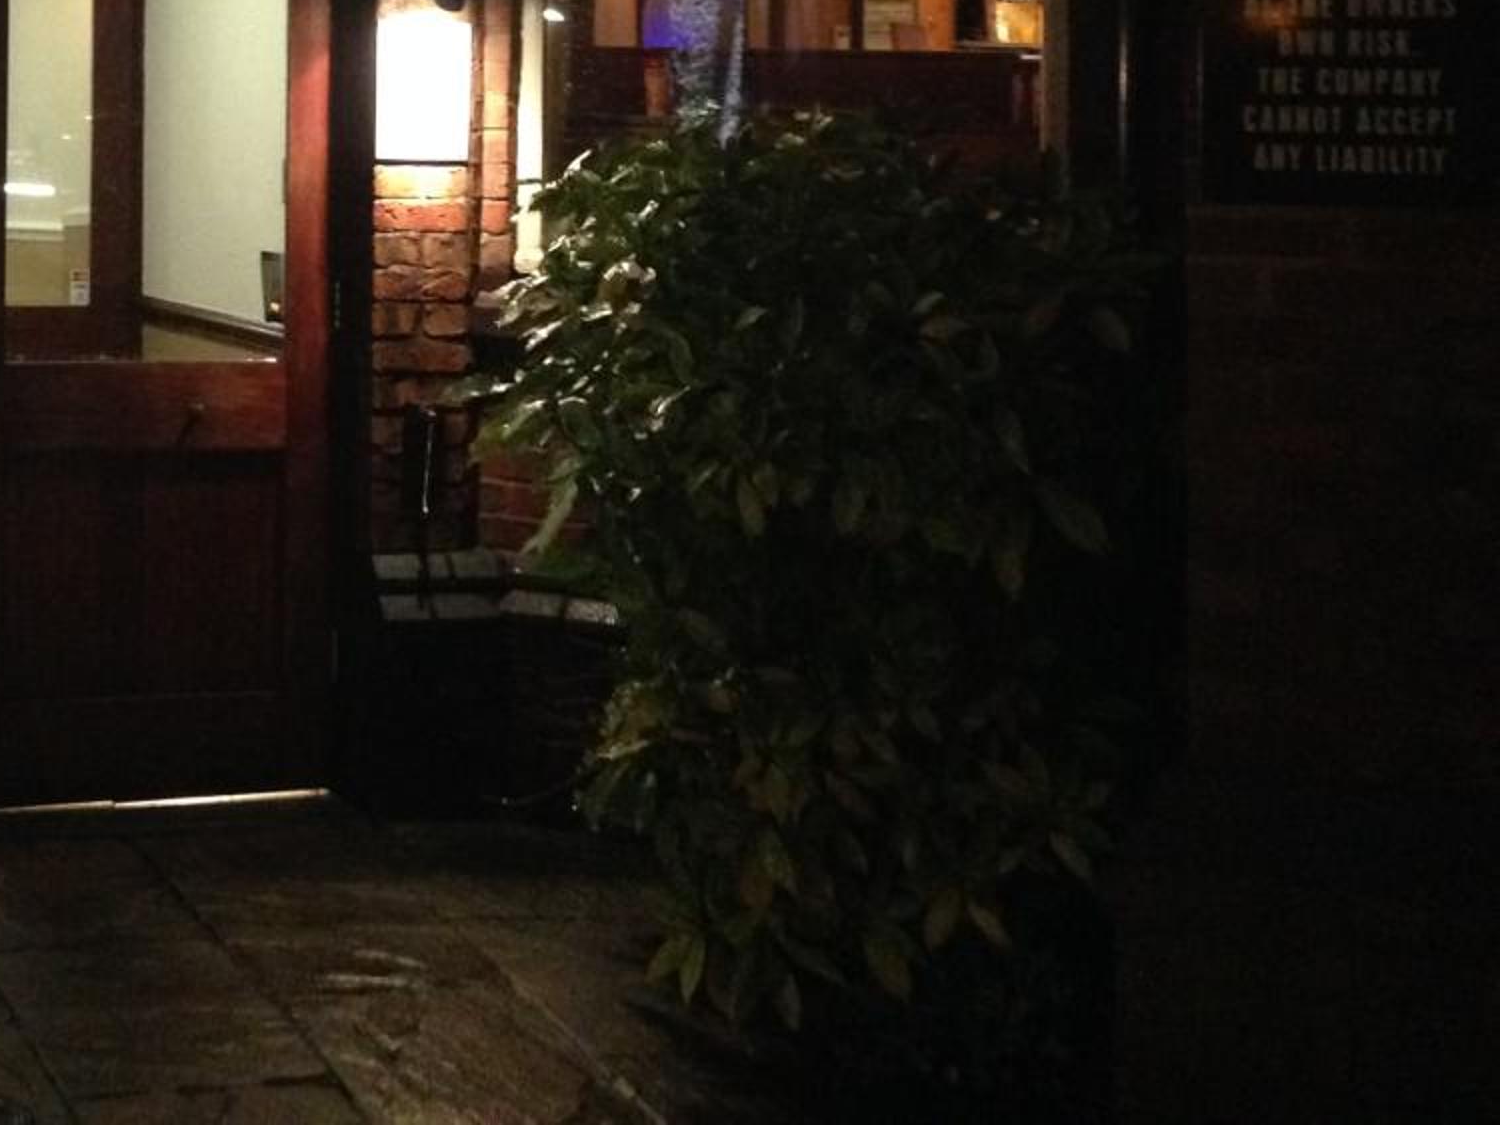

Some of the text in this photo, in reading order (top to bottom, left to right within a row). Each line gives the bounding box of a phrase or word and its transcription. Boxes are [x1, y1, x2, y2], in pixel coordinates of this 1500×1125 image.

[1276, 27, 1412, 56] OWN RISK
[1257, 68, 1443, 96] THE COMPANY
[1243, 106, 1457, 135] CANNOT ACCEPT
[1253, 144, 1444, 174] ANY LIABILITY
